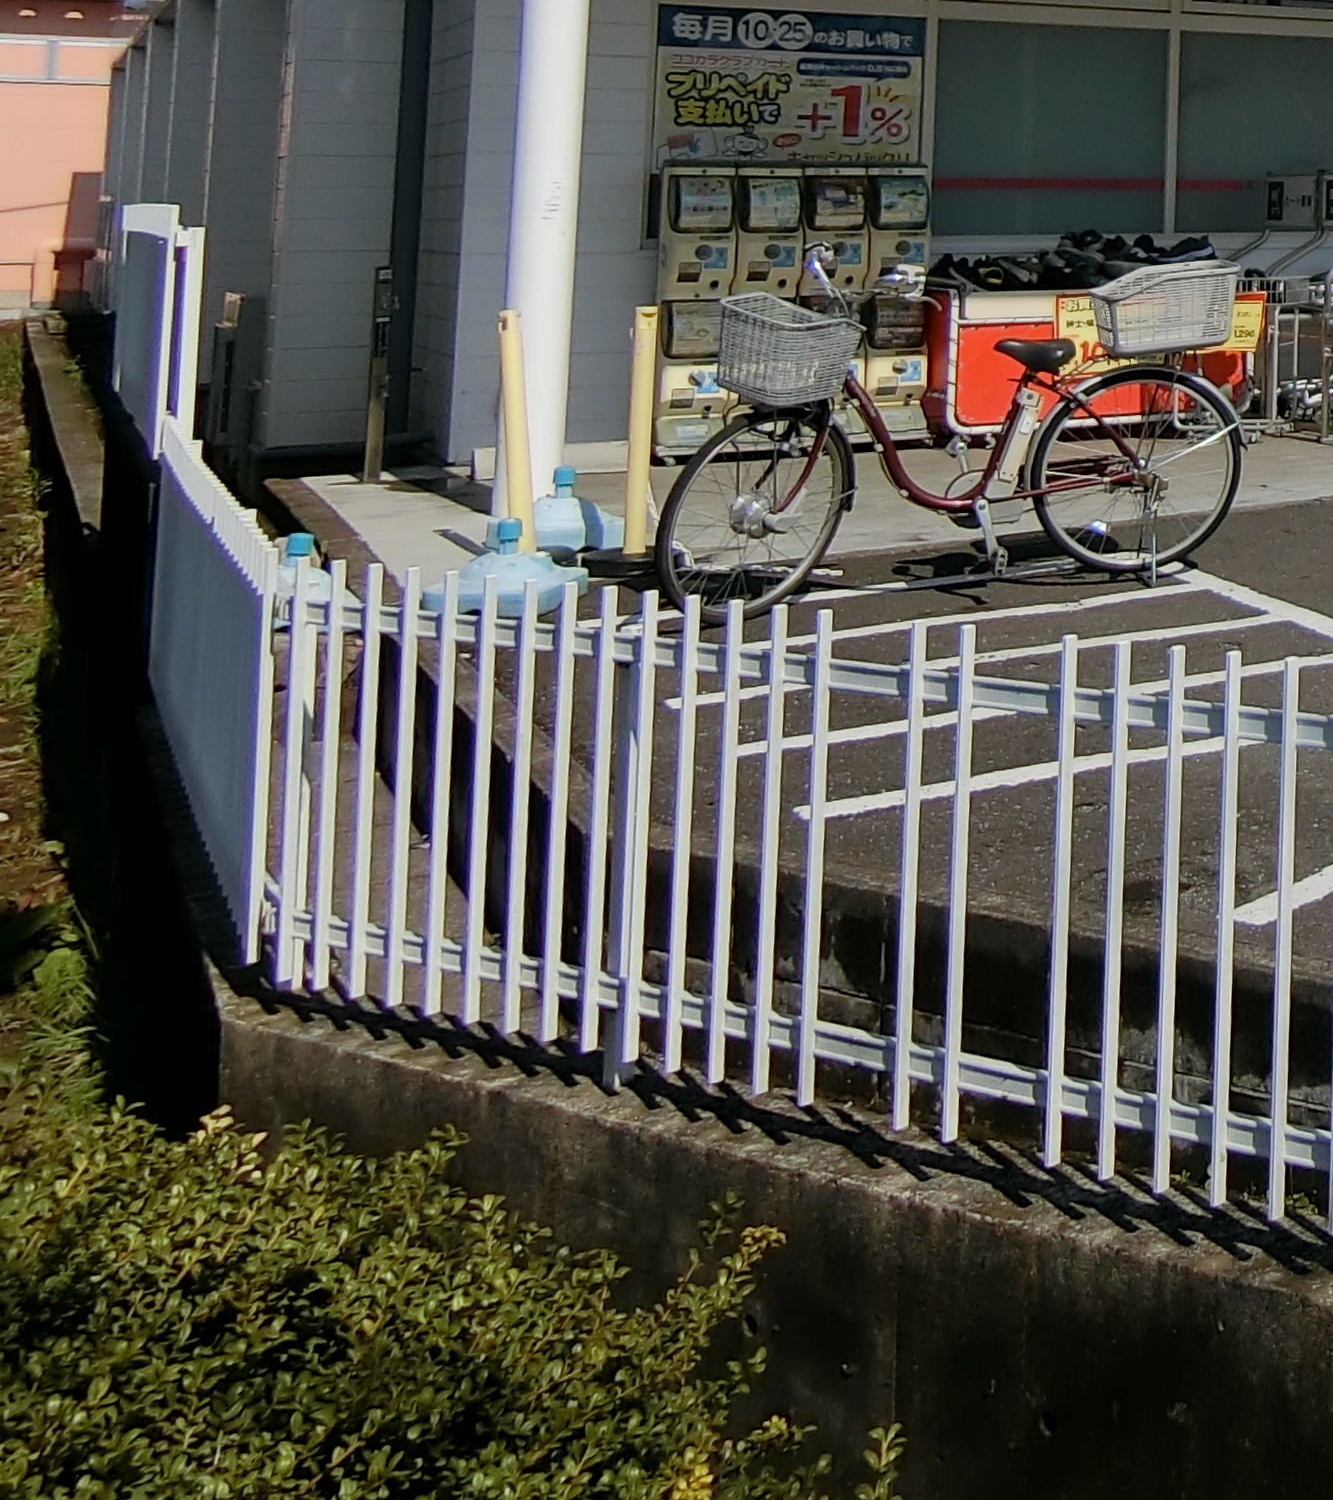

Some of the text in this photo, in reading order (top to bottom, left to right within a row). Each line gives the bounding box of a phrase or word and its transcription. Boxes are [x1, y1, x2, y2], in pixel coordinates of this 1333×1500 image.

[666, 71, 792, 100] プリペイド
[675, 100, 782, 124] 支払いで
